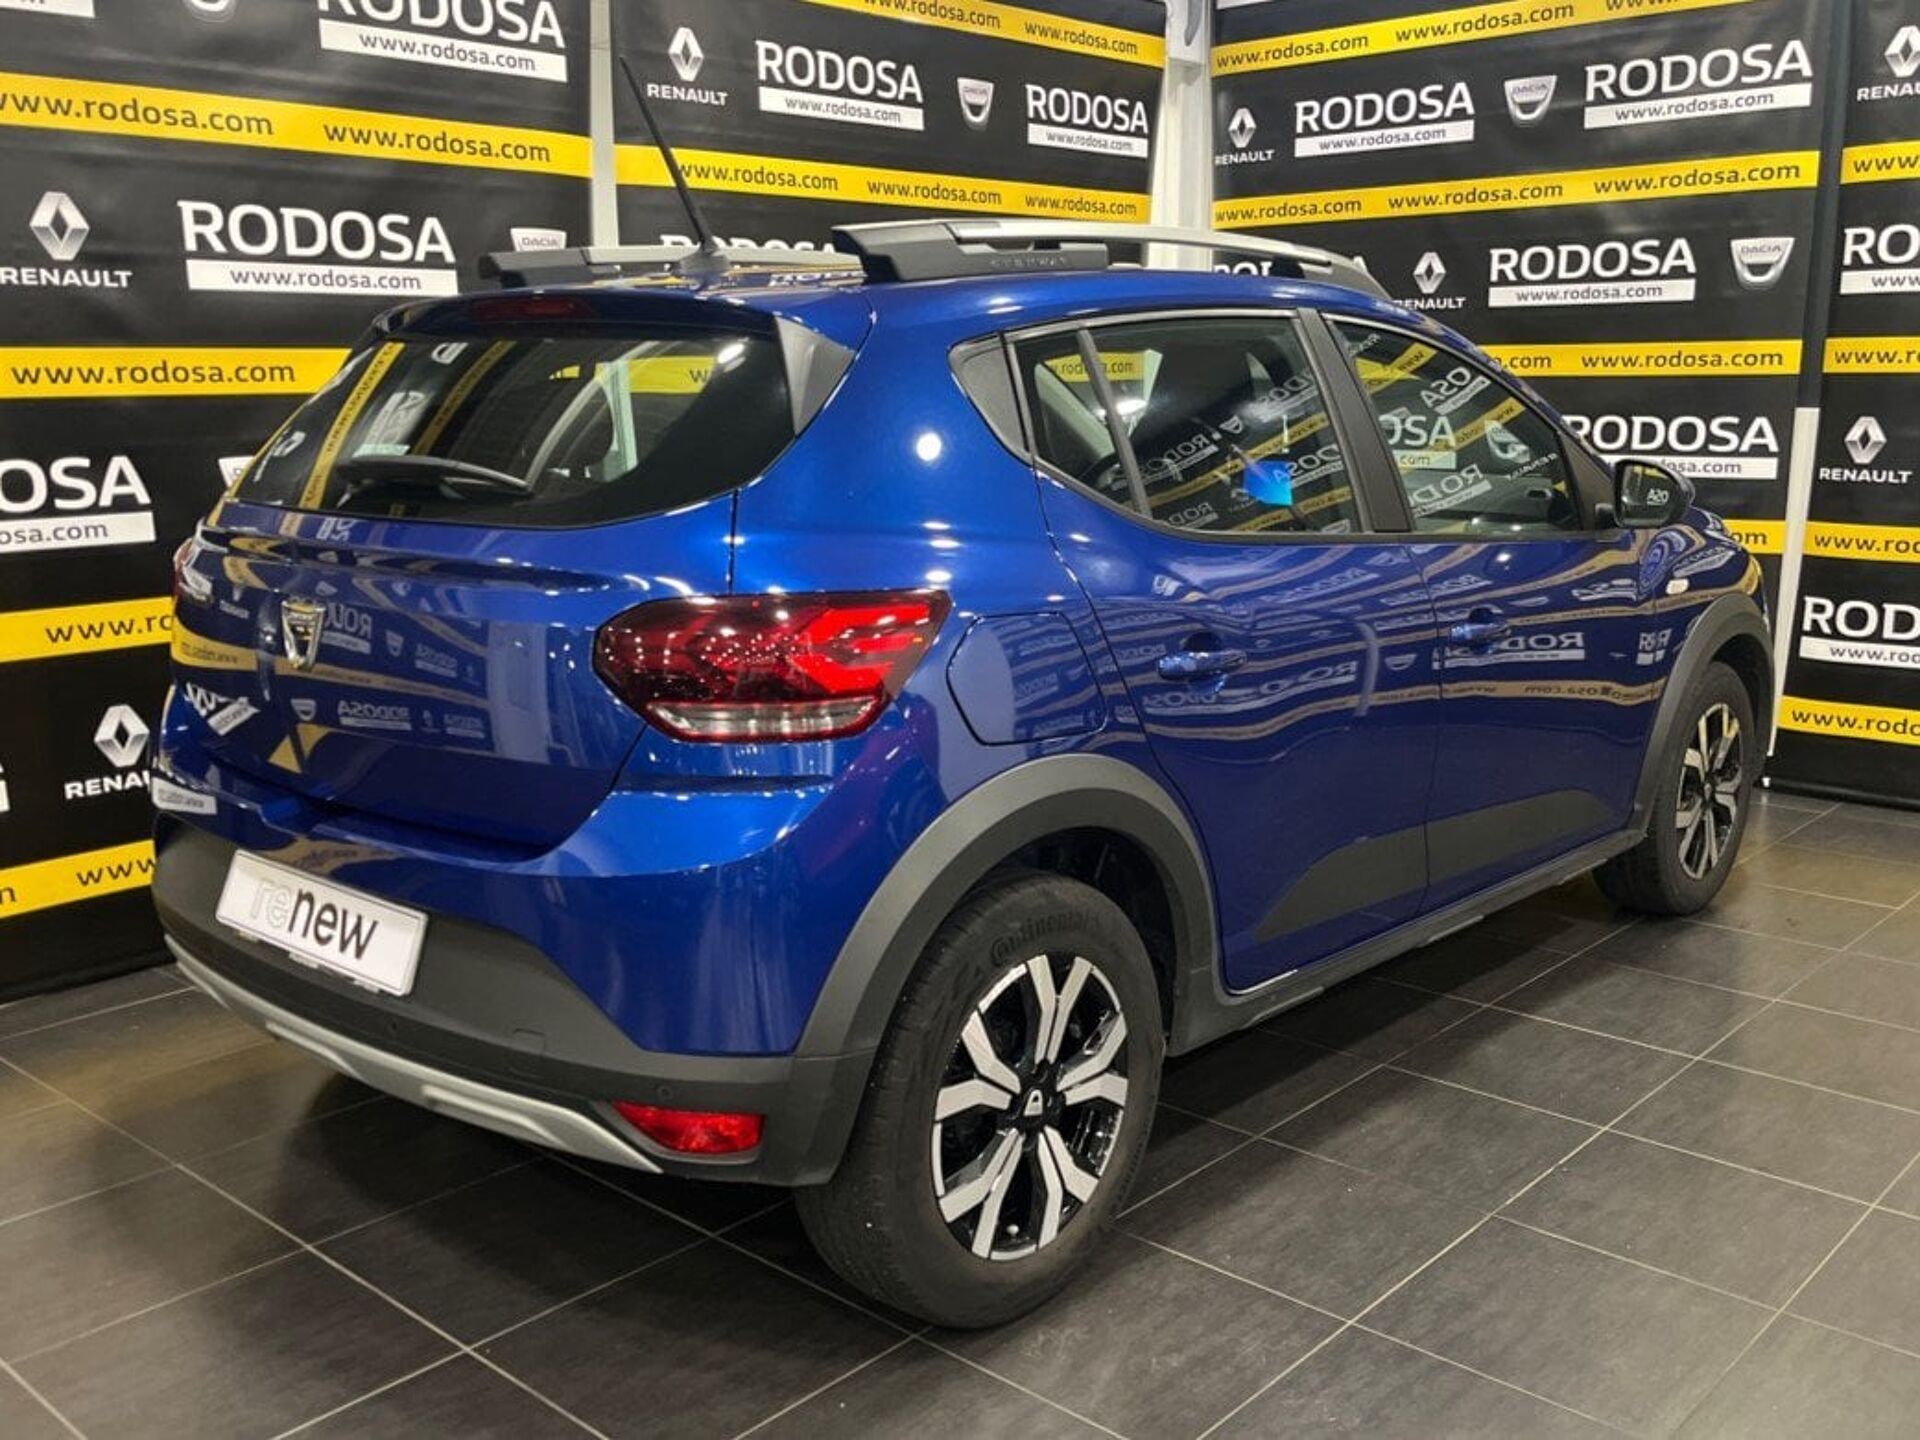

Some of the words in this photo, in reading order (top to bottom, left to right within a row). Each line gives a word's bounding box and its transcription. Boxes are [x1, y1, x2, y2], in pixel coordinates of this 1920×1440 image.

[359, 33, 536, 72] www.rodosa.com
[1024, 20, 1138, 55] www.rodosa.com
[1216, 34, 1369, 69] www.rodosa.com
[1395, 3, 1574, 43] www.rodosa.com
[755, 39, 924, 104] RODOSA
[1584, 39, 1813, 102] RODOSA
[646, 83, 728, 107] RENAULT
[785, 96, 901, 123] www.rodosa.com
[1025, 84, 1149, 134] RODOSA
[1294, 82, 1475, 135] RODOSA
[1614, 92, 1775, 121] www.rodosa.com
[323, 124, 551, 163] www.rodosa.com
[1046, 124, 1133, 151] www.rodosa.com
[1318, 126, 1447, 151] www.rodosa.com
[867, 179, 1002, 206] www.rodosa.com
[1025, 193, 1137, 217] www.rodosa.com
[1215, 199, 1362, 223] www.rodosa.com
[1387, 182, 1563, 210] www.rodosa.com
[1593, 162, 1800, 194] www.rodosa.com
[177, 199, 457, 264] RODOSA
[0, 266, 133, 288] RENAULT
[1489, 237, 1697, 283] RODOSA
[230, 266, 422, 291] www.rodosa.com
[1515, 284, 1663, 302] www.rodosa.com
[11, 360, 296, 385] www.rodosa.com
[1581, 350, 1784, 369] www.rodosa.com
[1561, 415, 1779, 453] RODOSA
[1819, 467, 1913, 484] RENAULT
